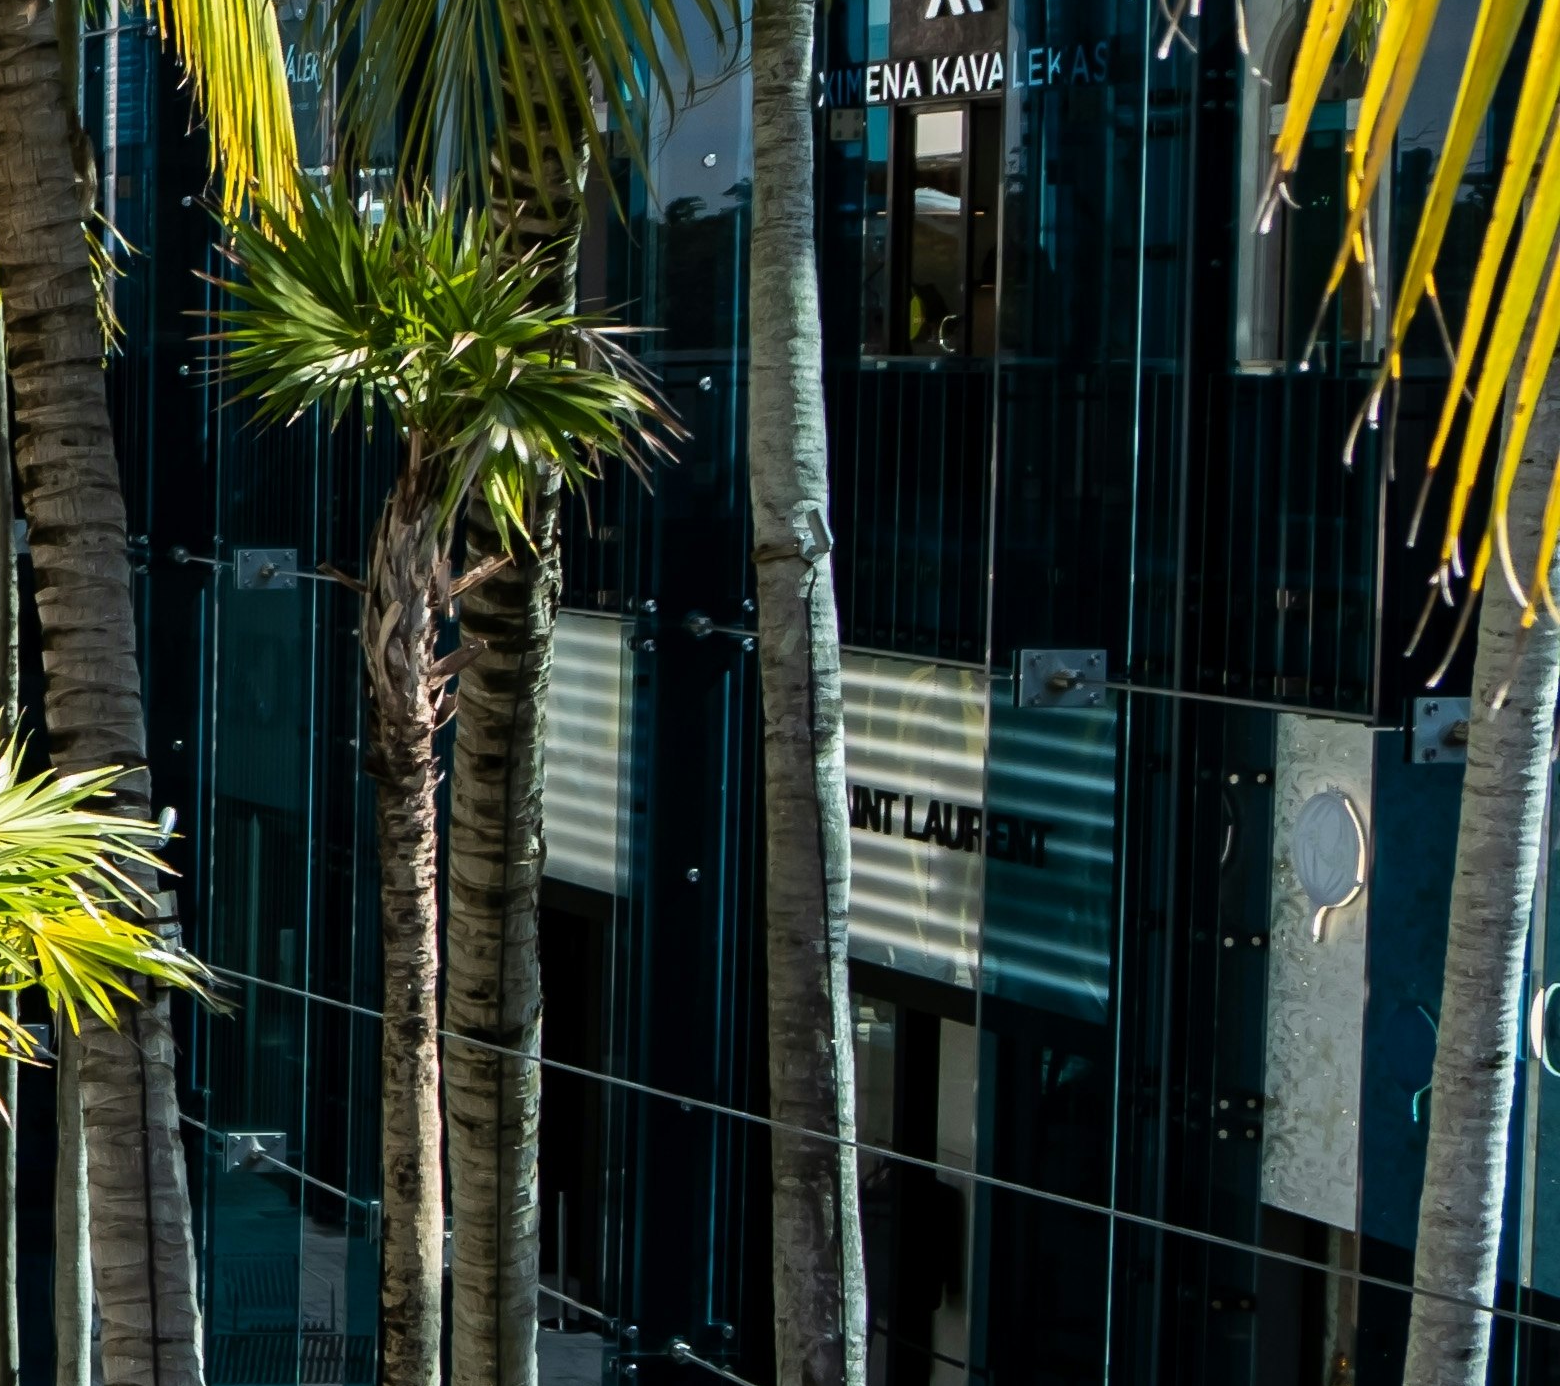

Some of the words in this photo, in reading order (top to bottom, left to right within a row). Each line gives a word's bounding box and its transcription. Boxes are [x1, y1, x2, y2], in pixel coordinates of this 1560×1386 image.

[817, 61, 923, 109] XIMENA
[931, 40, 1108, 96] KAVALEKAS
[903, 794, 1054, 869] LAURENT
